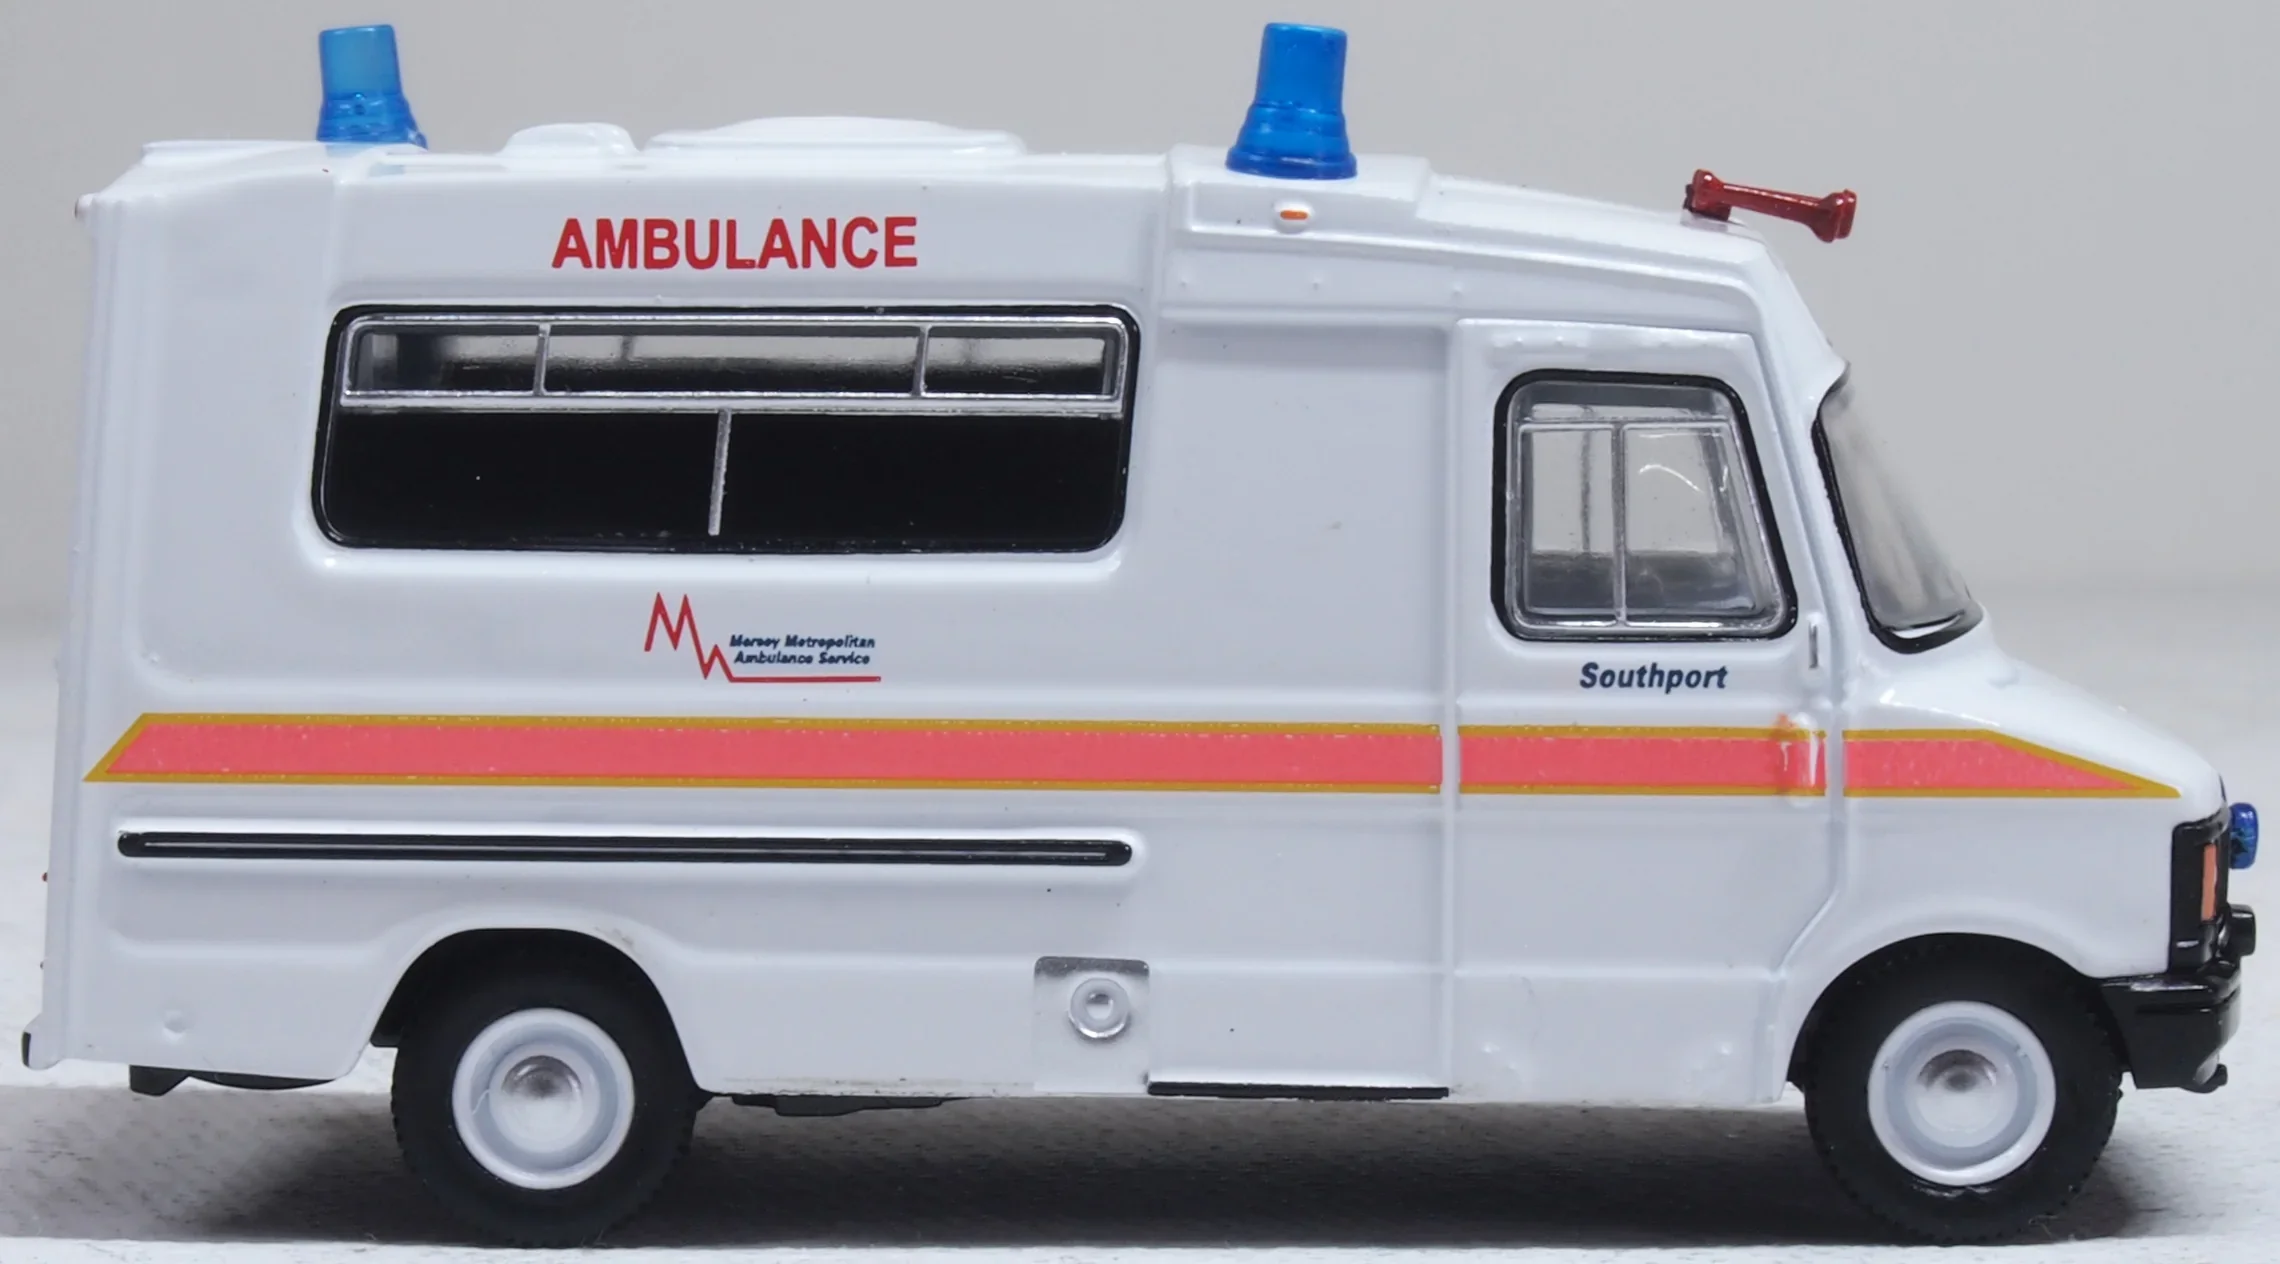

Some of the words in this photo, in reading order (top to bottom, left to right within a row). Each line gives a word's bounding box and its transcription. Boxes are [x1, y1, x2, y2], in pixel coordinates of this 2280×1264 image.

[552, 216, 918, 270] AMBULANCE
[729, 634, 780, 651] Mersey
[784, 634, 876, 650] Metropolitan
[733, 650, 814, 665] Ambulance
[818, 651, 871, 666] Service
[1579, 662, 1729, 695] Southport
